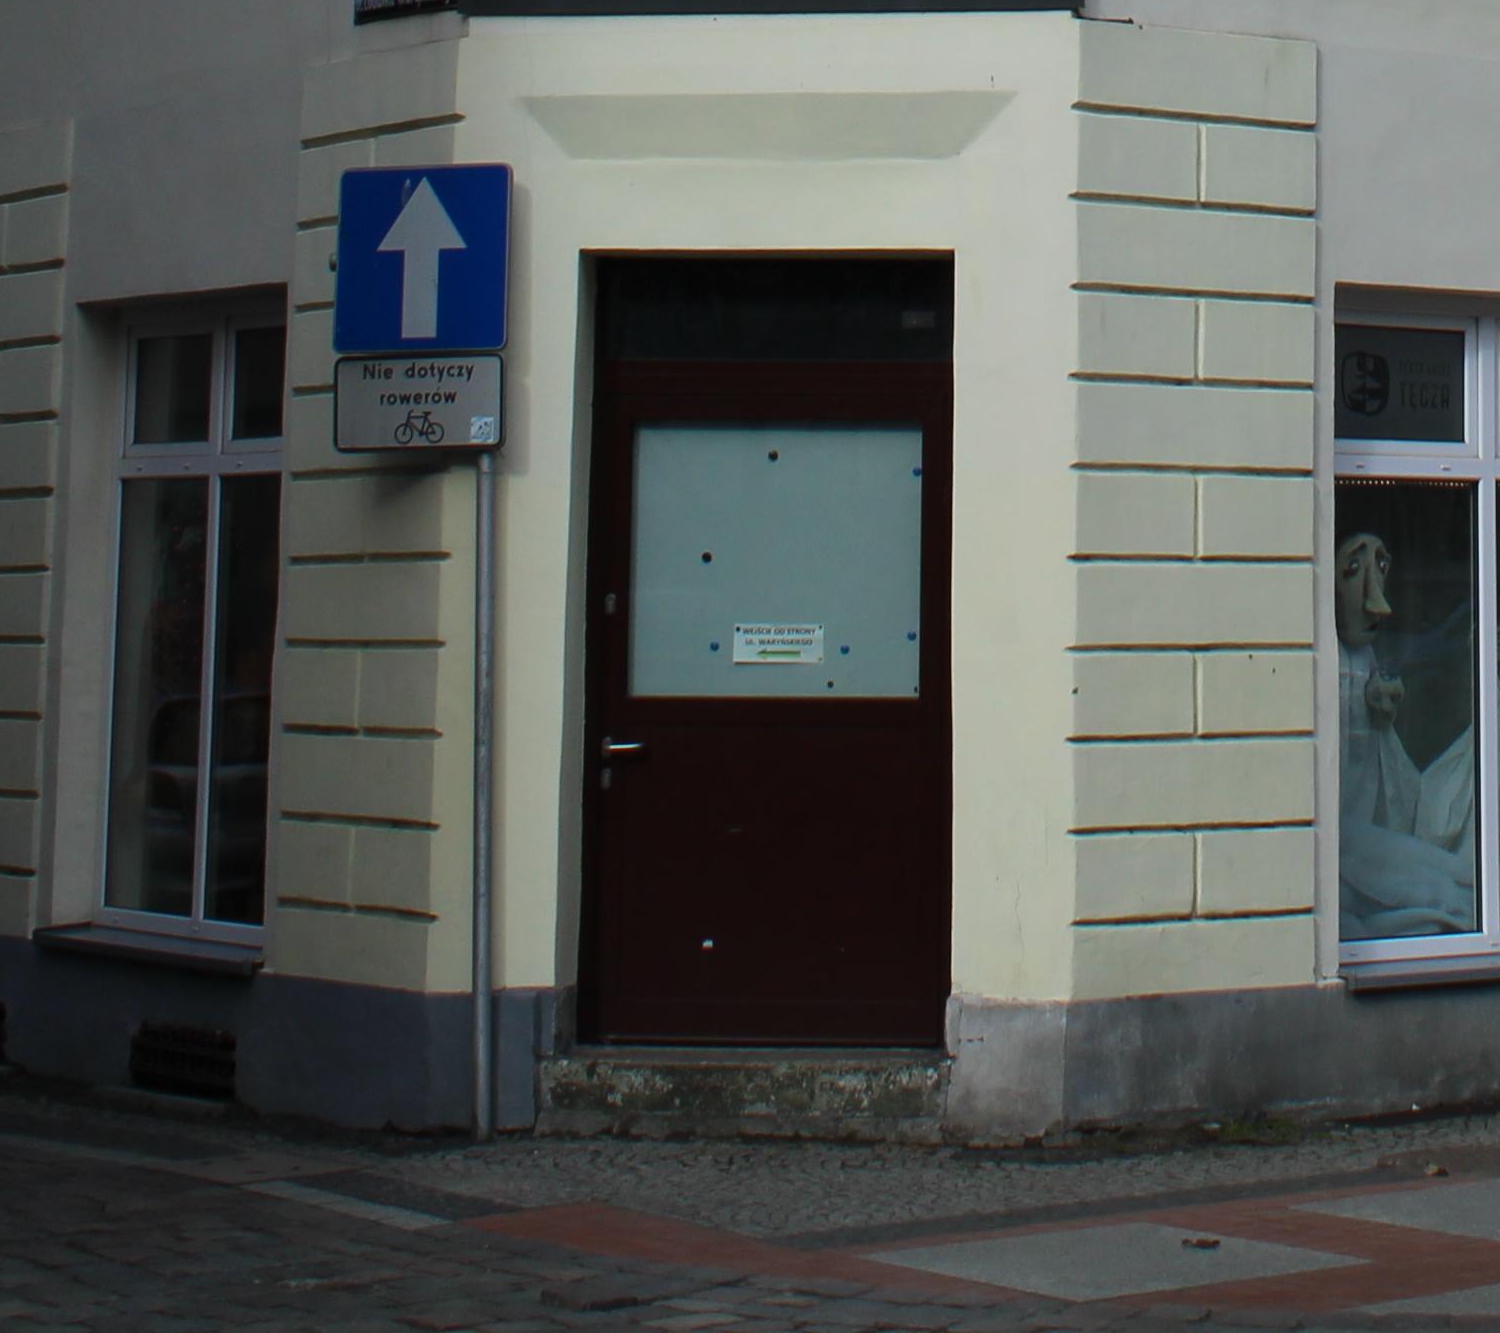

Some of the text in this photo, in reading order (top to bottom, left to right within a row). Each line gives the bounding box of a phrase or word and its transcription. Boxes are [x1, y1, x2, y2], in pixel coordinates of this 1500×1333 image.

[362, 362, 476, 383] Nie dotyczy
[379, 387, 458, 406] rowerów
